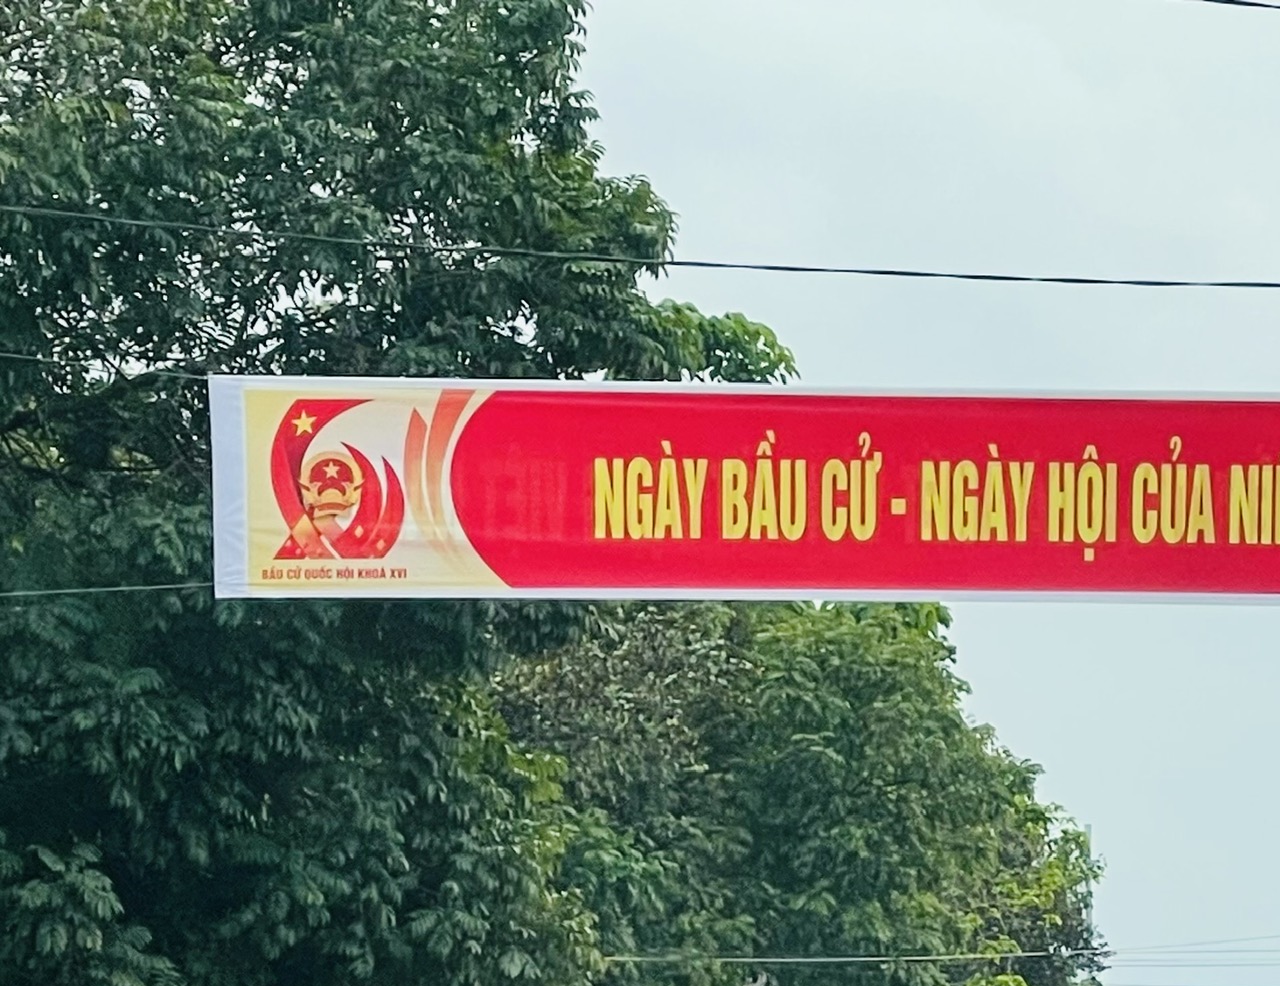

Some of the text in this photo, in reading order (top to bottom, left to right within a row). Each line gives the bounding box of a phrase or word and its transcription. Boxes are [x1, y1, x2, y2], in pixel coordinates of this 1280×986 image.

[594, 441, 708, 540] NGÀY
[722, 430, 806, 541] BẦU
[822, 431, 882, 541] CỬ
[921, 444, 1034, 541] NGÀY
[1048, 445, 1117, 561] HỘI
[1132, 436, 1215, 543] CỦA
[390, 568, 407, 579] XVI
